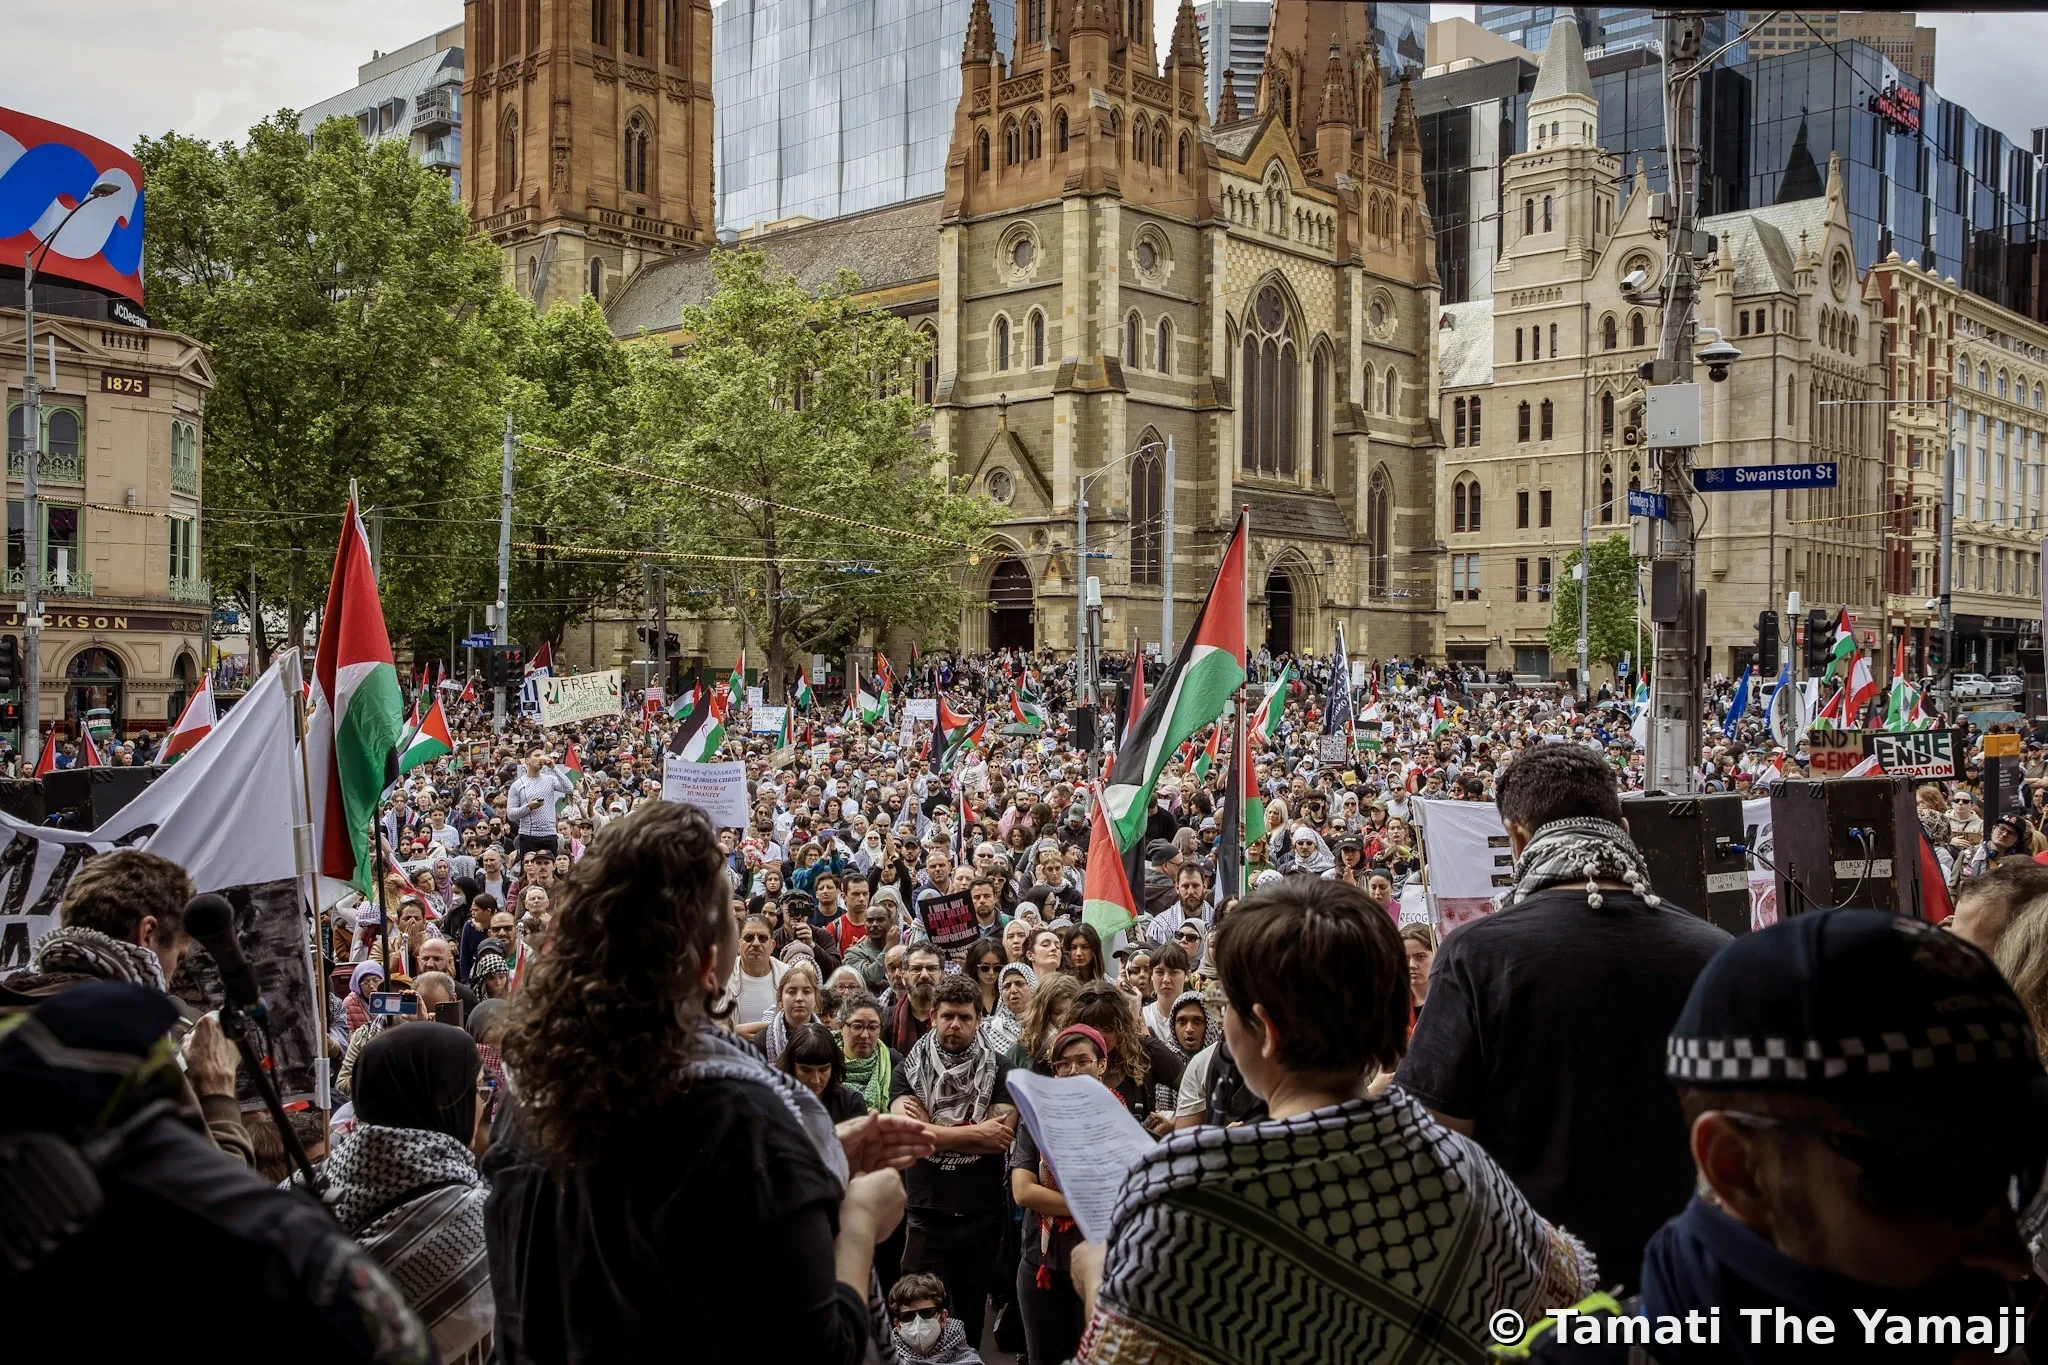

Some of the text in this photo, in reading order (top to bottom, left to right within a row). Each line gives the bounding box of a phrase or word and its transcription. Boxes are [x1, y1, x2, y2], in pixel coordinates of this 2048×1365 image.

[1897, 86, 1920, 110] JOHN
[1879, 97, 1919, 132] HOLLAND
[114, 303, 148, 328] JCDecaux
[2007, 335, 2042, 362] WELCH
[107, 377, 143, 393] 1875
[1735, 464, 1832, 483] Swanston St
[1629, 491, 1656, 509] Flinders St
[6, 613, 128, 629] JCKSON
[561, 676, 600, 692] FREE
[562, 686, 607, 701] PALESTINE
[547, 702, 565, 712] STOP
[549, 706, 574, 720] BOYCOTT
[575, 703, 605, 714] APARTHEID
[909, 700, 934, 709] Google
[1810, 730, 1848, 748] END
[1895, 732, 1951, 762] THE
[1876, 739, 1932, 767] END
[684, 767, 701, 775] MARY
[1887, 764, 1953, 776] CCUPATION
[667, 774, 692, 782] MOTHER
[719, 776, 742, 784] CHRIST
[687, 790, 721, 798] HUMANITY
[927, 905, 969, 922] STAY SILENT
[928, 898, 964, 914] I WILL NOT
[958, 912, 973, 921] YOU
[1400, 912, 1428, 923] RECOG
[931, 926, 978, 944] COMFORTABLE
[936, 921, 968, 936] CAN STAY
[942, 1154, 982, 1164] FESTIVAL
